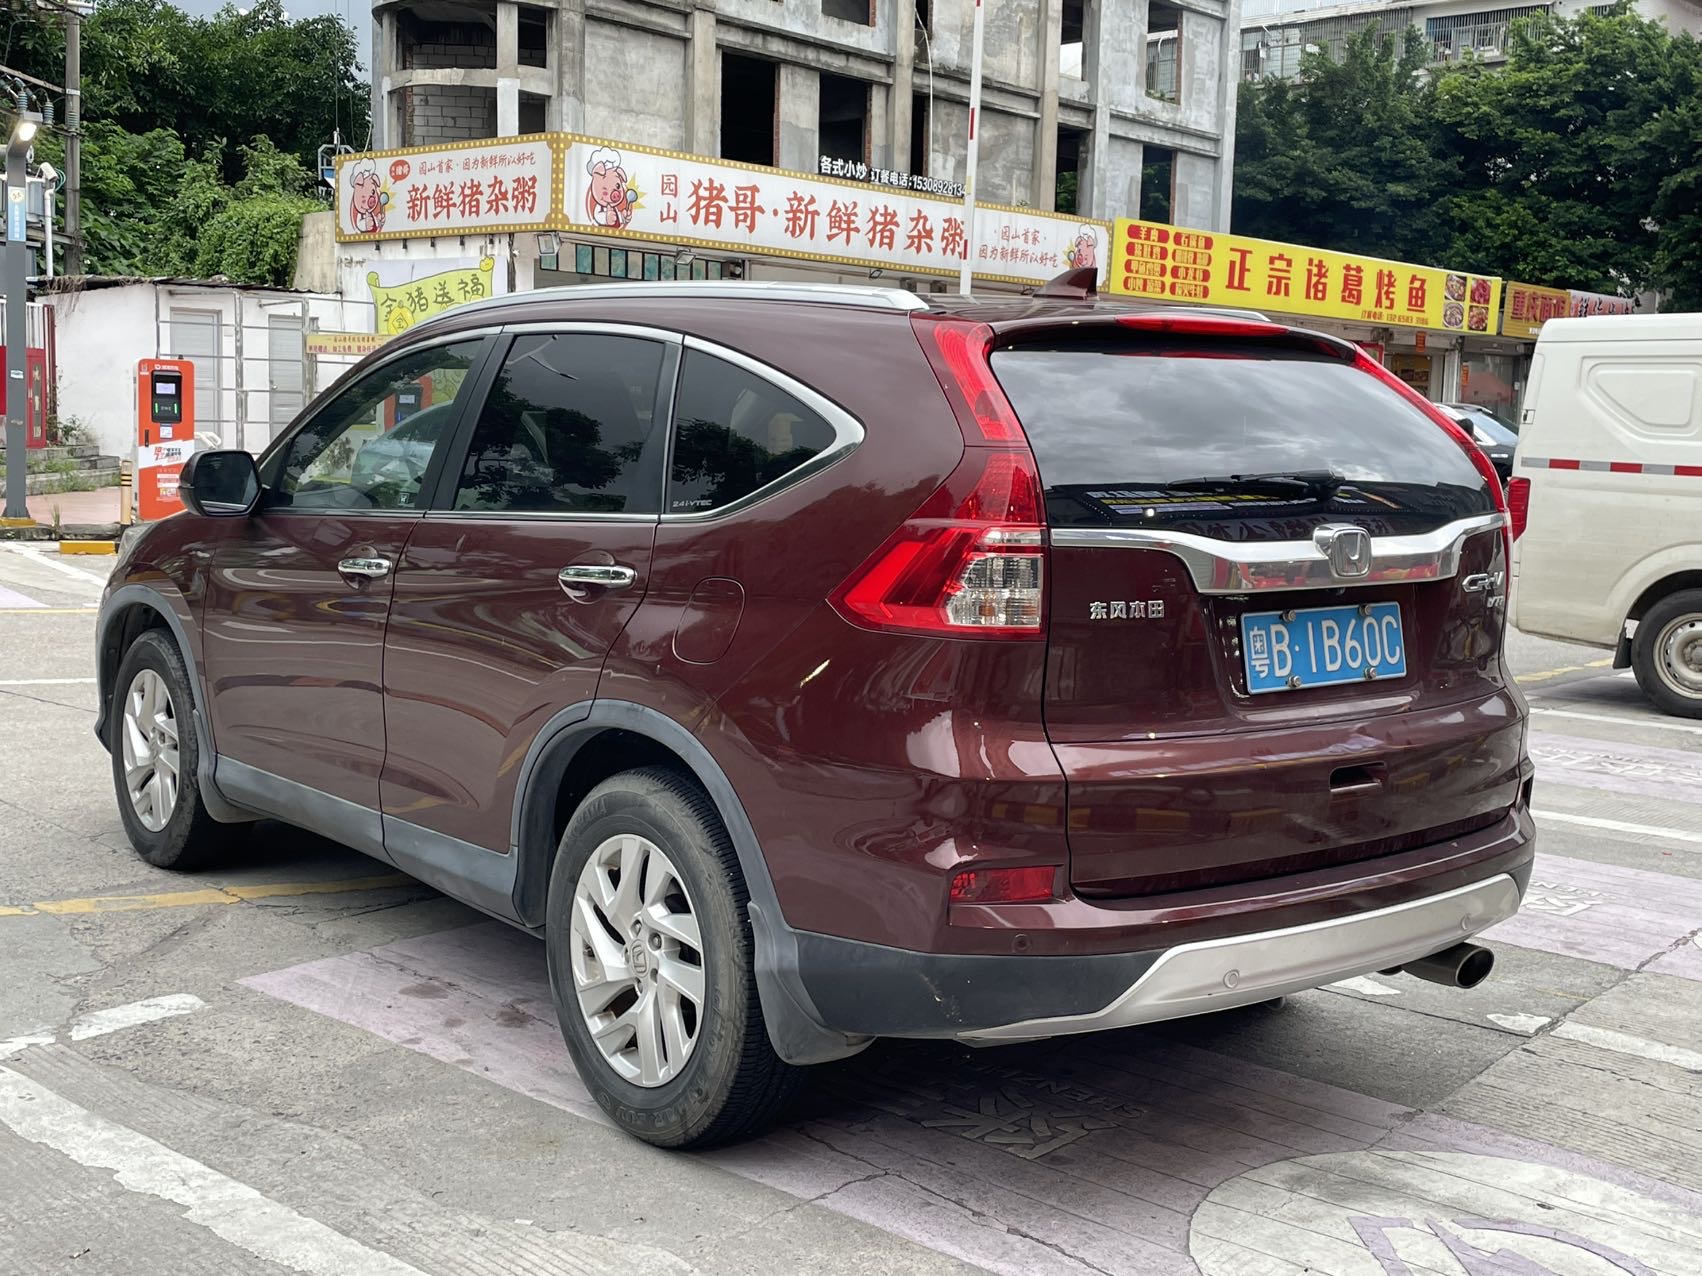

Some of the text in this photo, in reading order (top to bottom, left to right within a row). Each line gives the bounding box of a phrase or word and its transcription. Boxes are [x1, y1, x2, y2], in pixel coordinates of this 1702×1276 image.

[820, 155, 868, 180] 各式小炒
[407, 175, 538, 222] 新鲜猪杂粥
[660, 173, 678, 224] 园山
[1226, 247, 1426, 313] 正宗诸葛烤鱼
[1089, 600, 1165, 620] 东风本田
